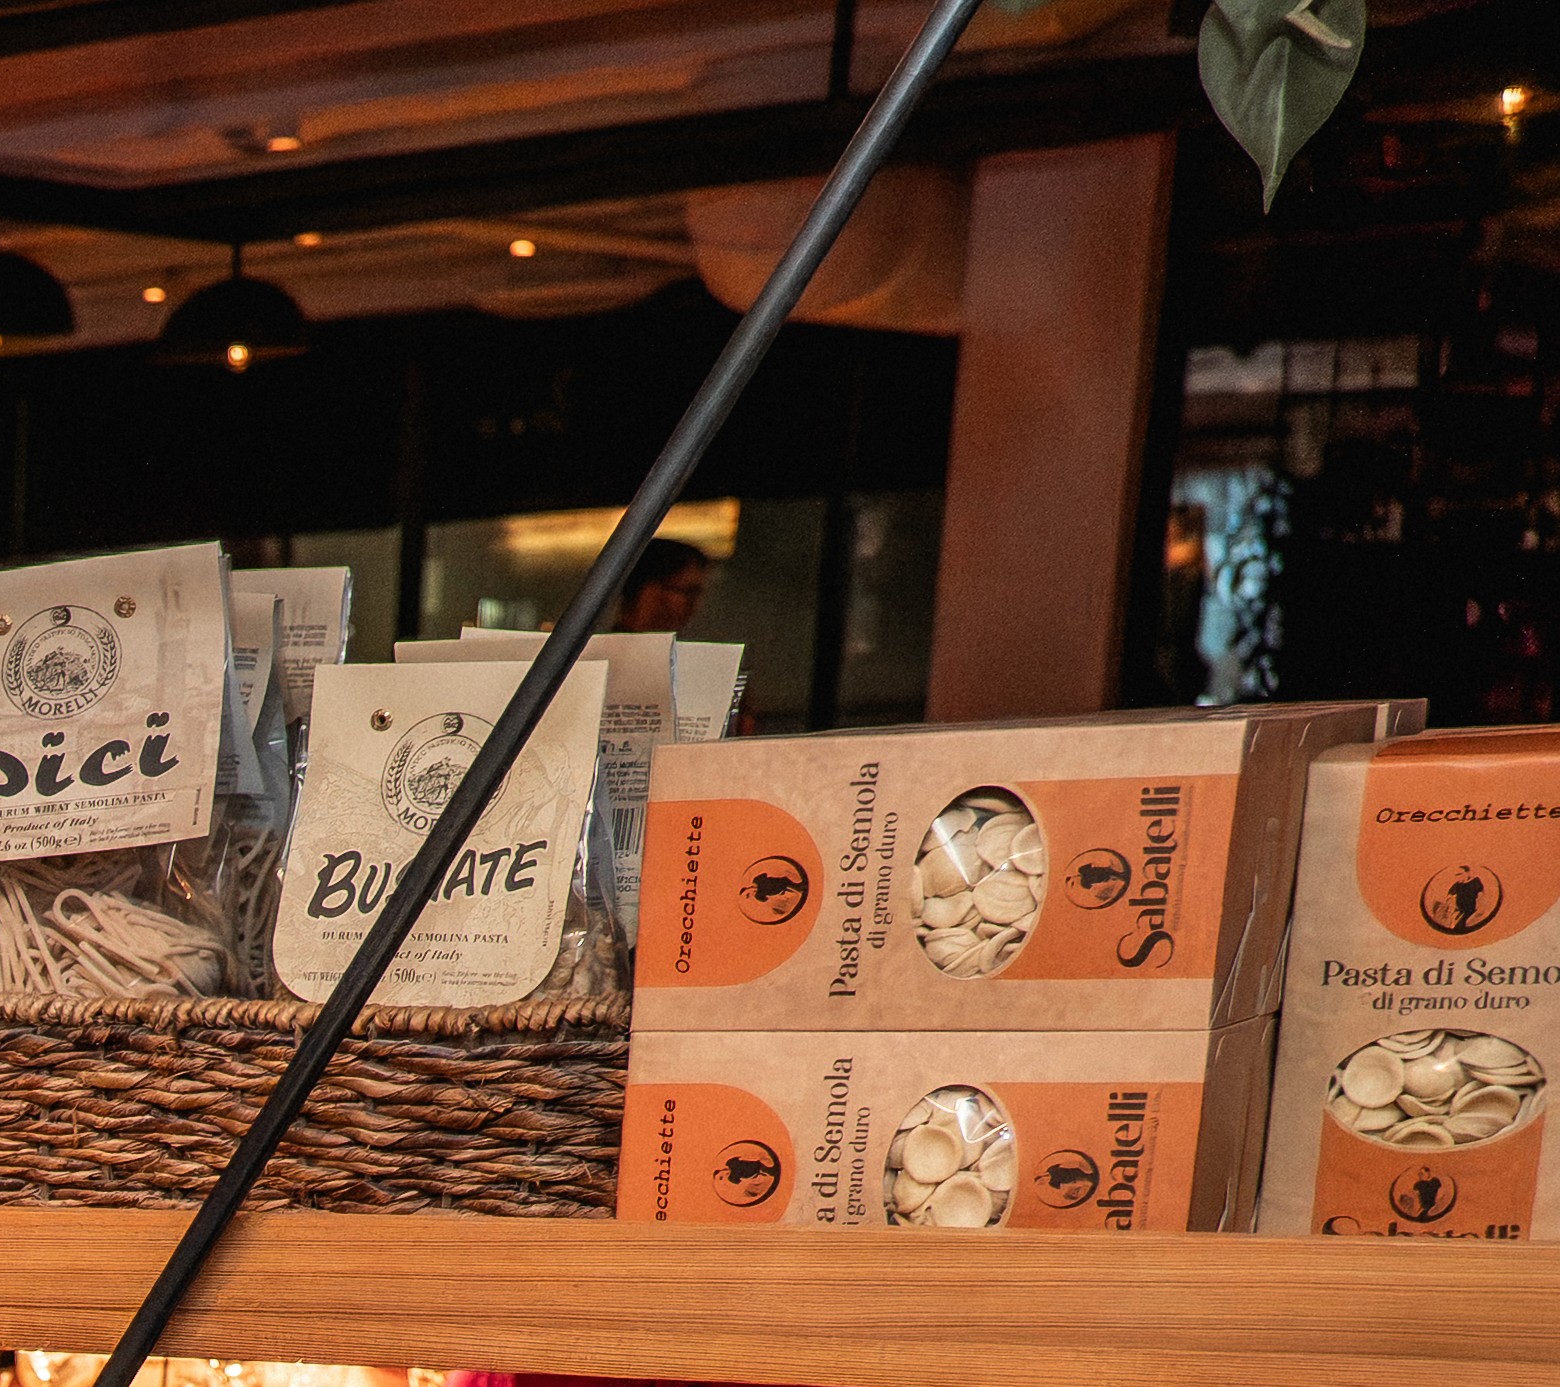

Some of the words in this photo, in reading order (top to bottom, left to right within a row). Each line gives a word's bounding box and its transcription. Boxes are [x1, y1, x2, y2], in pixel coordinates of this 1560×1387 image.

[21, 688, 99, 716] MORELLI
[34, 802, 70, 815] WHEAT
[74, 796, 129, 810] SEMOLINA
[133, 792, 167, 805] PASTA
[839, 761, 880, 872] Semola
[1376, 803, 1560, 824] Orecchiette
[3, 821, 50, 834] Product
[52, 818, 68, 830] of
[70, 816, 99, 828] Italy
[876, 811, 899, 860] duro
[14, 842, 28, 851] oz
[306, 840, 548, 919] BUATE
[675, 815, 703, 974] Orecchiette
[837, 880, 865, 908] di
[873, 865, 894, 926] grano
[1116, 786, 1181, 969] Sabatelli
[322, 930, 363, 941] DURUM
[409, 932, 469, 942] SEMOLINA
[473, 933, 509, 944] PASTA
[432, 950, 463, 962] Italy
[865, 931, 886, 950] di
[828, 916, 863, 998] Pasta
[1321, 959, 1412, 987] Pasta
[1422, 959, 1455, 986] di
[1463, 957, 1560, 987] Semo
[1372, 991, 1394, 1010] di
[1398, 995, 1467, 1016] grano
[1474, 991, 1530, 1010] duro
[813, 1056, 854, 1163] Semola
[848, 1106, 872, 1154] duro
[655, 1099, 676, 1222] ecchiette
[1096, 1092, 1148, 1231] abatelli
[811, 1169, 841, 1198] di
[847, 1158, 866, 1218] grano
